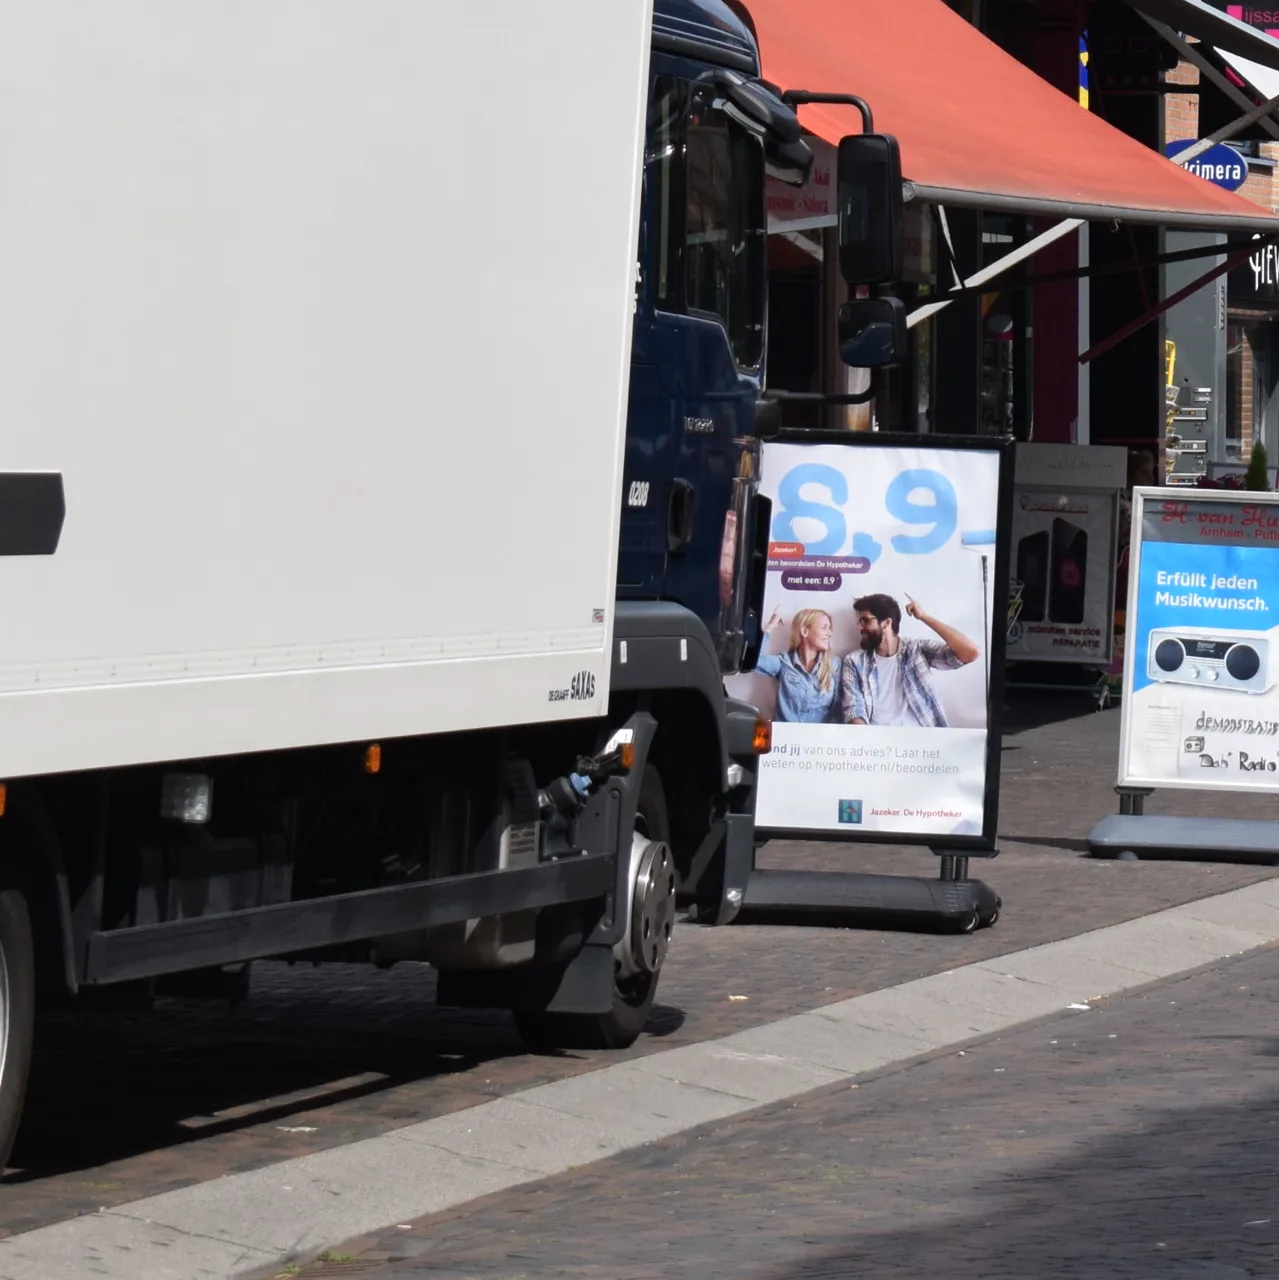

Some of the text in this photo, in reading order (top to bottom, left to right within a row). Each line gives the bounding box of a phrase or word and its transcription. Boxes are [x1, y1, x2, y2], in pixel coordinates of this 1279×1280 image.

[1184, 159, 1241, 180] rimera
[1197, 512, 1233, 525] van
[1200, 527, 1243, 539] Arnhem
[780, 560, 815, 568] beoordelen
[826, 561, 863, 570] Hypotheker
[805, 577, 821, 585] een:
[1157, 571, 1257, 590] Erfüllt jeden
[1155, 591, 1269, 611] Musikwunsch.
[1068, 626, 1100, 637] service
[1052, 639, 1100, 648] REPARATIE
[571, 671, 596, 700] SAXAS
[804, 747, 823, 756] van
[826, 748, 846, 756] ons
[850, 747, 892, 757] advies?
[895, 748, 919, 758] Laat
[922, 749, 940, 759] het
[762, 760, 959, 774] weten op hypotheker.nl/beoordelen
[870, 807, 964, 819] Jazeker. De Hypotheker.
